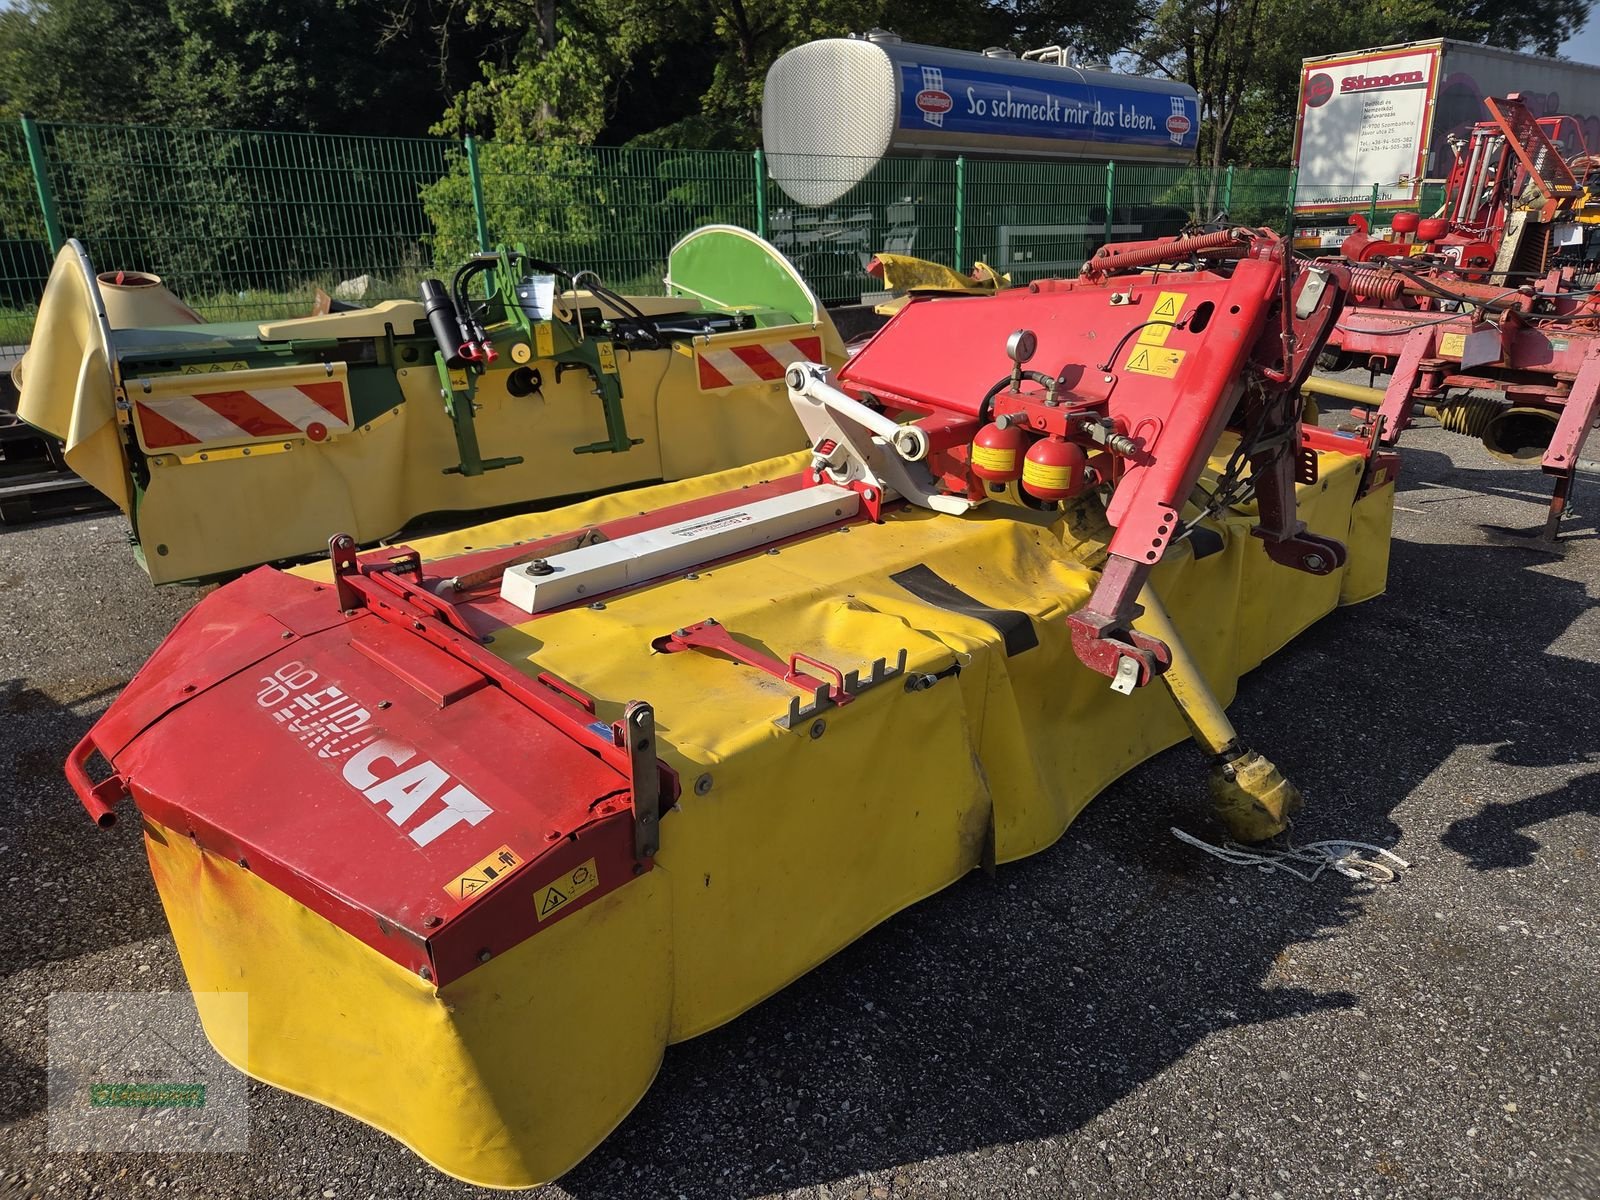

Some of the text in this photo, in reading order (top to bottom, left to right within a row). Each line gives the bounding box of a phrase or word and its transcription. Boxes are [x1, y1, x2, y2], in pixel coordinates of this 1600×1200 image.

[1340, 71, 1423, 91] Simon
[967, 86, 986, 115] So
[991, 90, 1060, 122] schmeckt
[1064, 103, 1089, 124] mir
[1093, 101, 1115, 127] das
